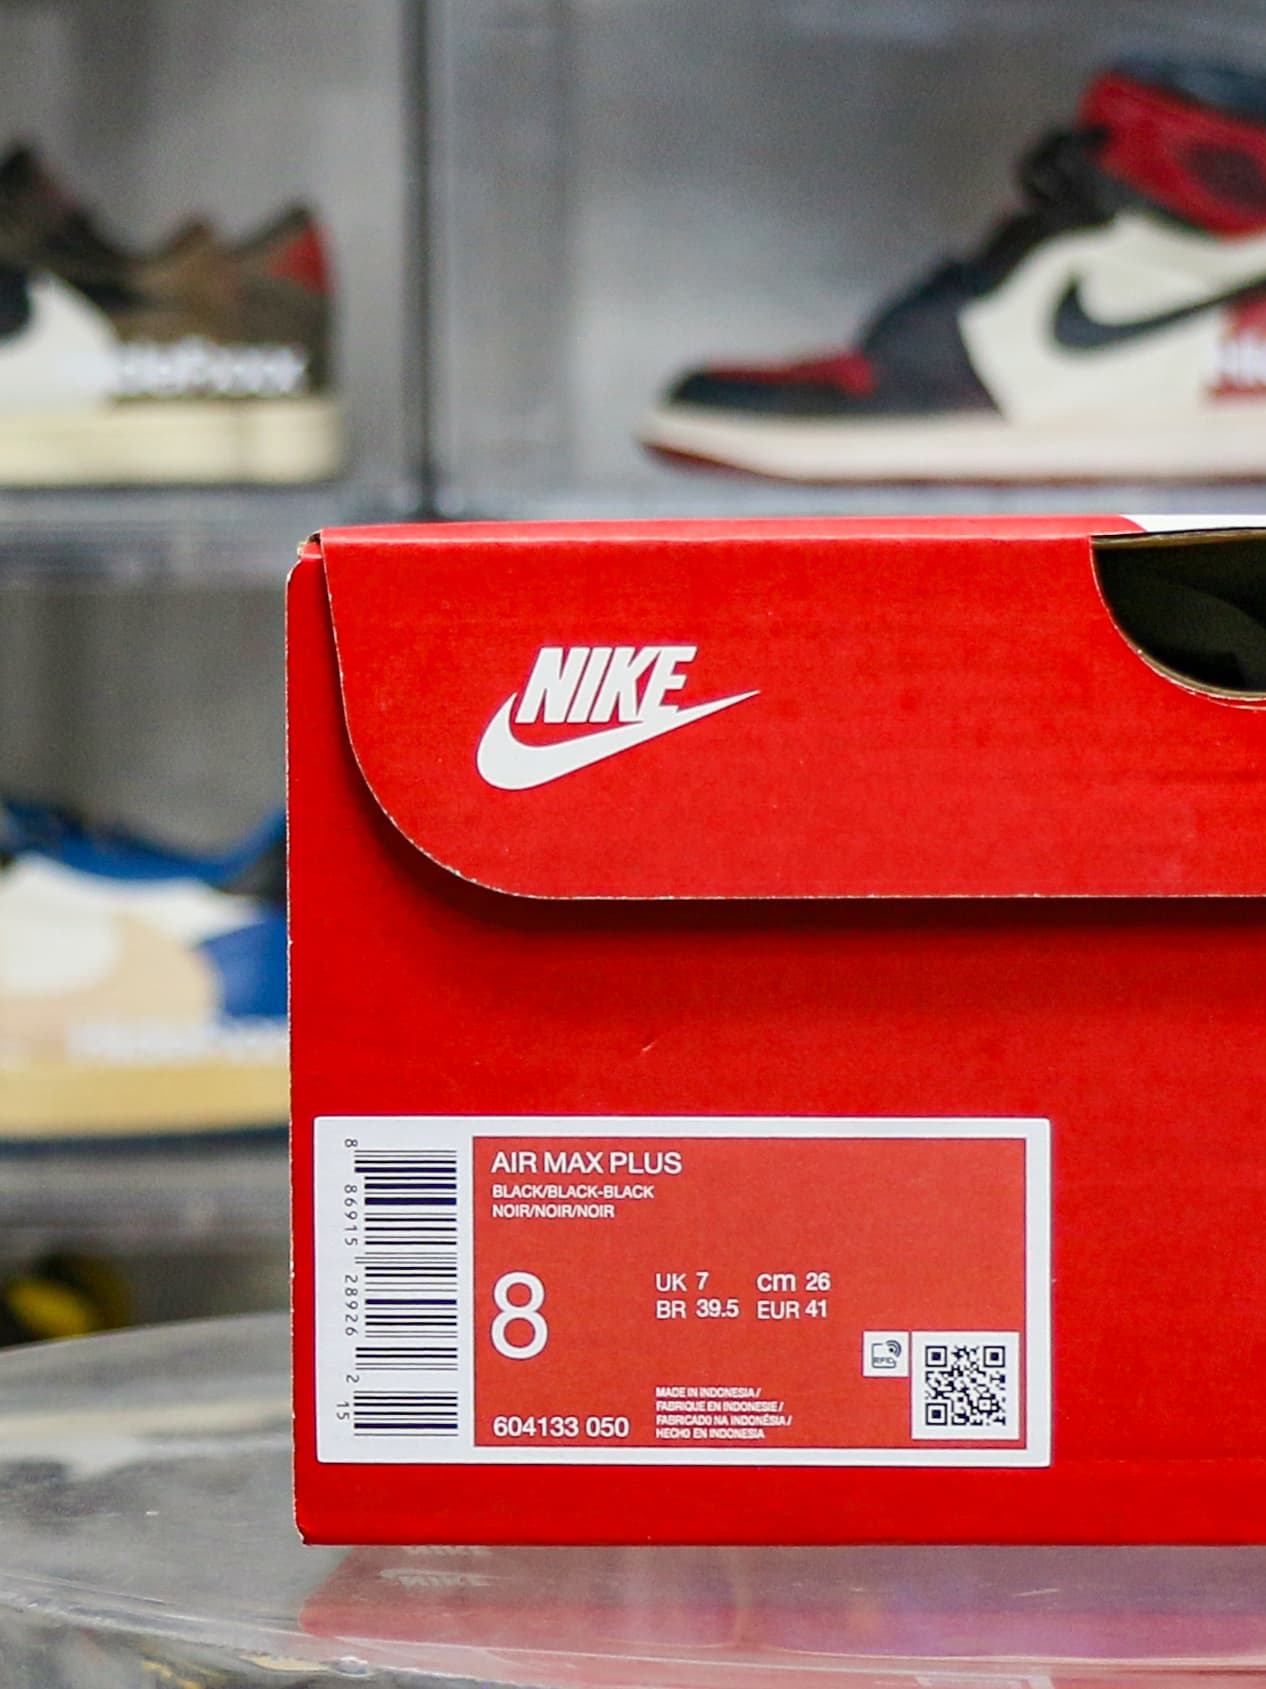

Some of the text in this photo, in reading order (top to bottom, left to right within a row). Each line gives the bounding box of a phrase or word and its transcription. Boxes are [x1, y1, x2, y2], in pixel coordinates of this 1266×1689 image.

[514, 646, 697, 724] NIKE
[490, 1151, 683, 1175] AIR MAX PLUS
[492, 1184, 655, 1199] BLACK/BLACK-BLACK
[492, 1203, 615, 1219] NOIR/NOIR/NOIR
[344, 1138, 360, 1384] 8 86915 28926 2
[655, 1271, 710, 1292] UK 7
[756, 1271, 831, 1292] cm 26
[490, 1271, 549, 1360] 8
[656, 1298, 740, 1319] BR 39.5
[757, 1299, 828, 1319] EUR 41
[656, 1387, 686, 1398] MADE
[687, 1387, 698, 1398] IN
[656, 1401, 706, 1412] FABRIQUE
[707, 1401, 722, 1412] EN
[493, 1416, 630, 1438] 604133 050
[656, 1415, 712, 1426] FABRICADO
[713, 1415, 729, 1426] NA
[656, 1428, 691, 1439] HECHO
[693, 1428, 708, 1439] EN
